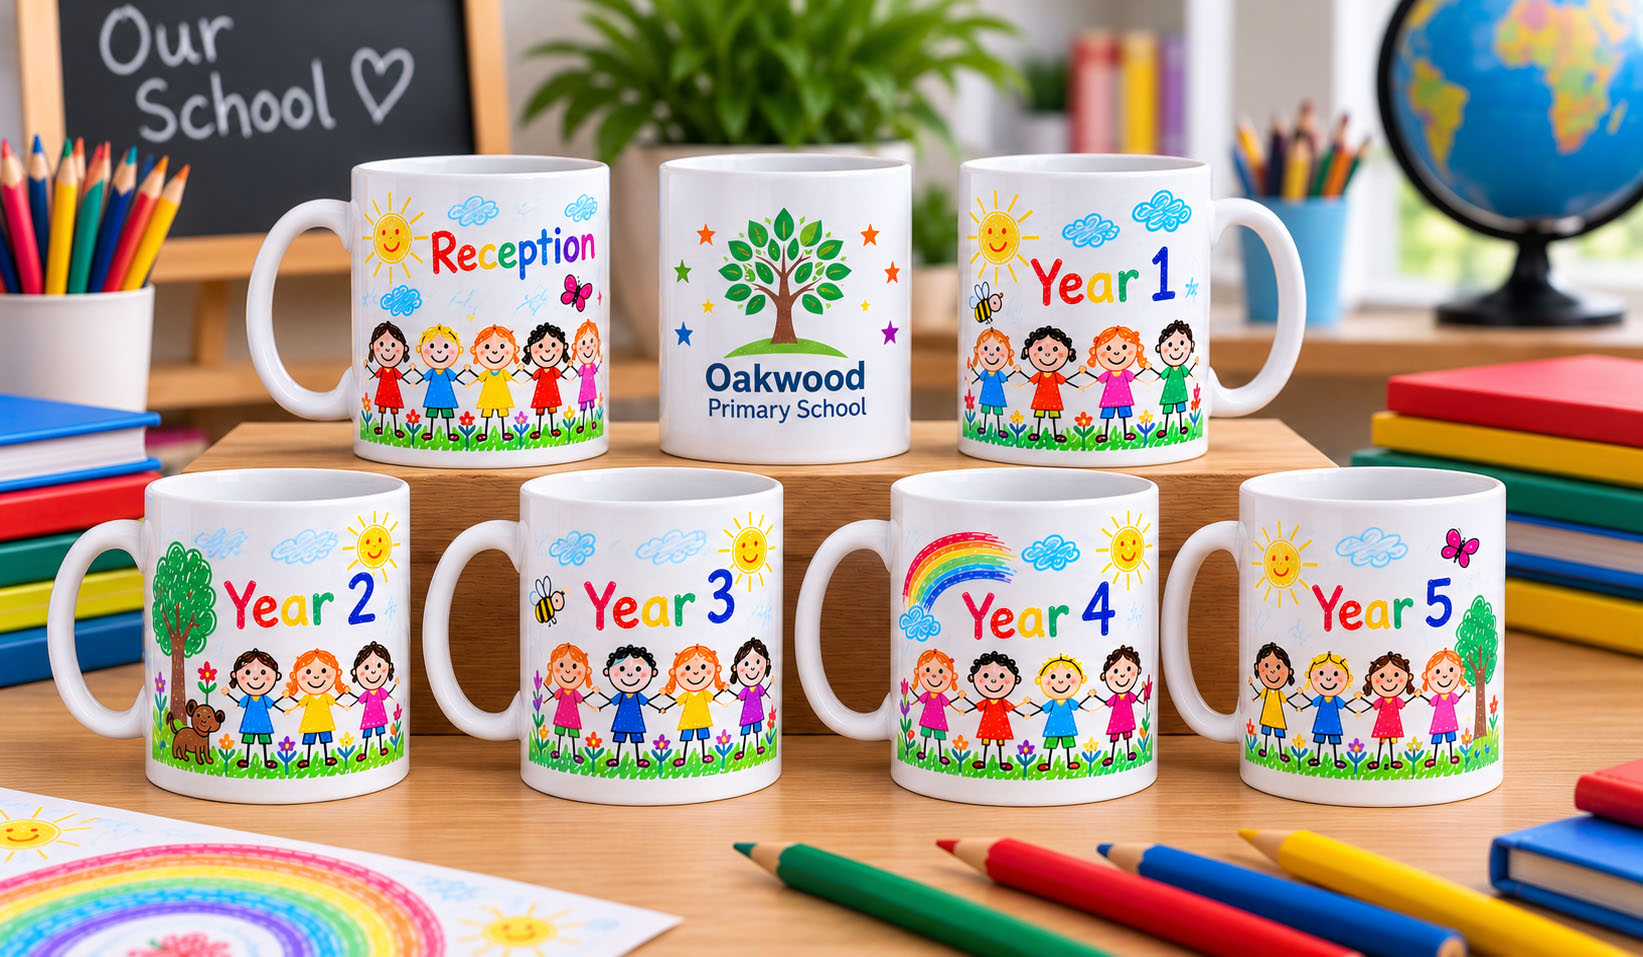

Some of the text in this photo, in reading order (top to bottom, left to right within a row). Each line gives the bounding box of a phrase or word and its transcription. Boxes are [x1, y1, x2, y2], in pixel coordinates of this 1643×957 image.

[100, 4, 233, 75] Our
[135, 58, 336, 142] School
[430, 226, 596, 280] Reception
[1030, 246, 1176, 306] Year 1
[705, 361, 866, 393] Oakwood
[709, 396, 867, 423] Primary School
[224, 571, 377, 630] Year 2
[583, 567, 736, 630] Year 3
[961, 580, 1117, 640] Year 4
[1311, 577, 1454, 631] Year 5
